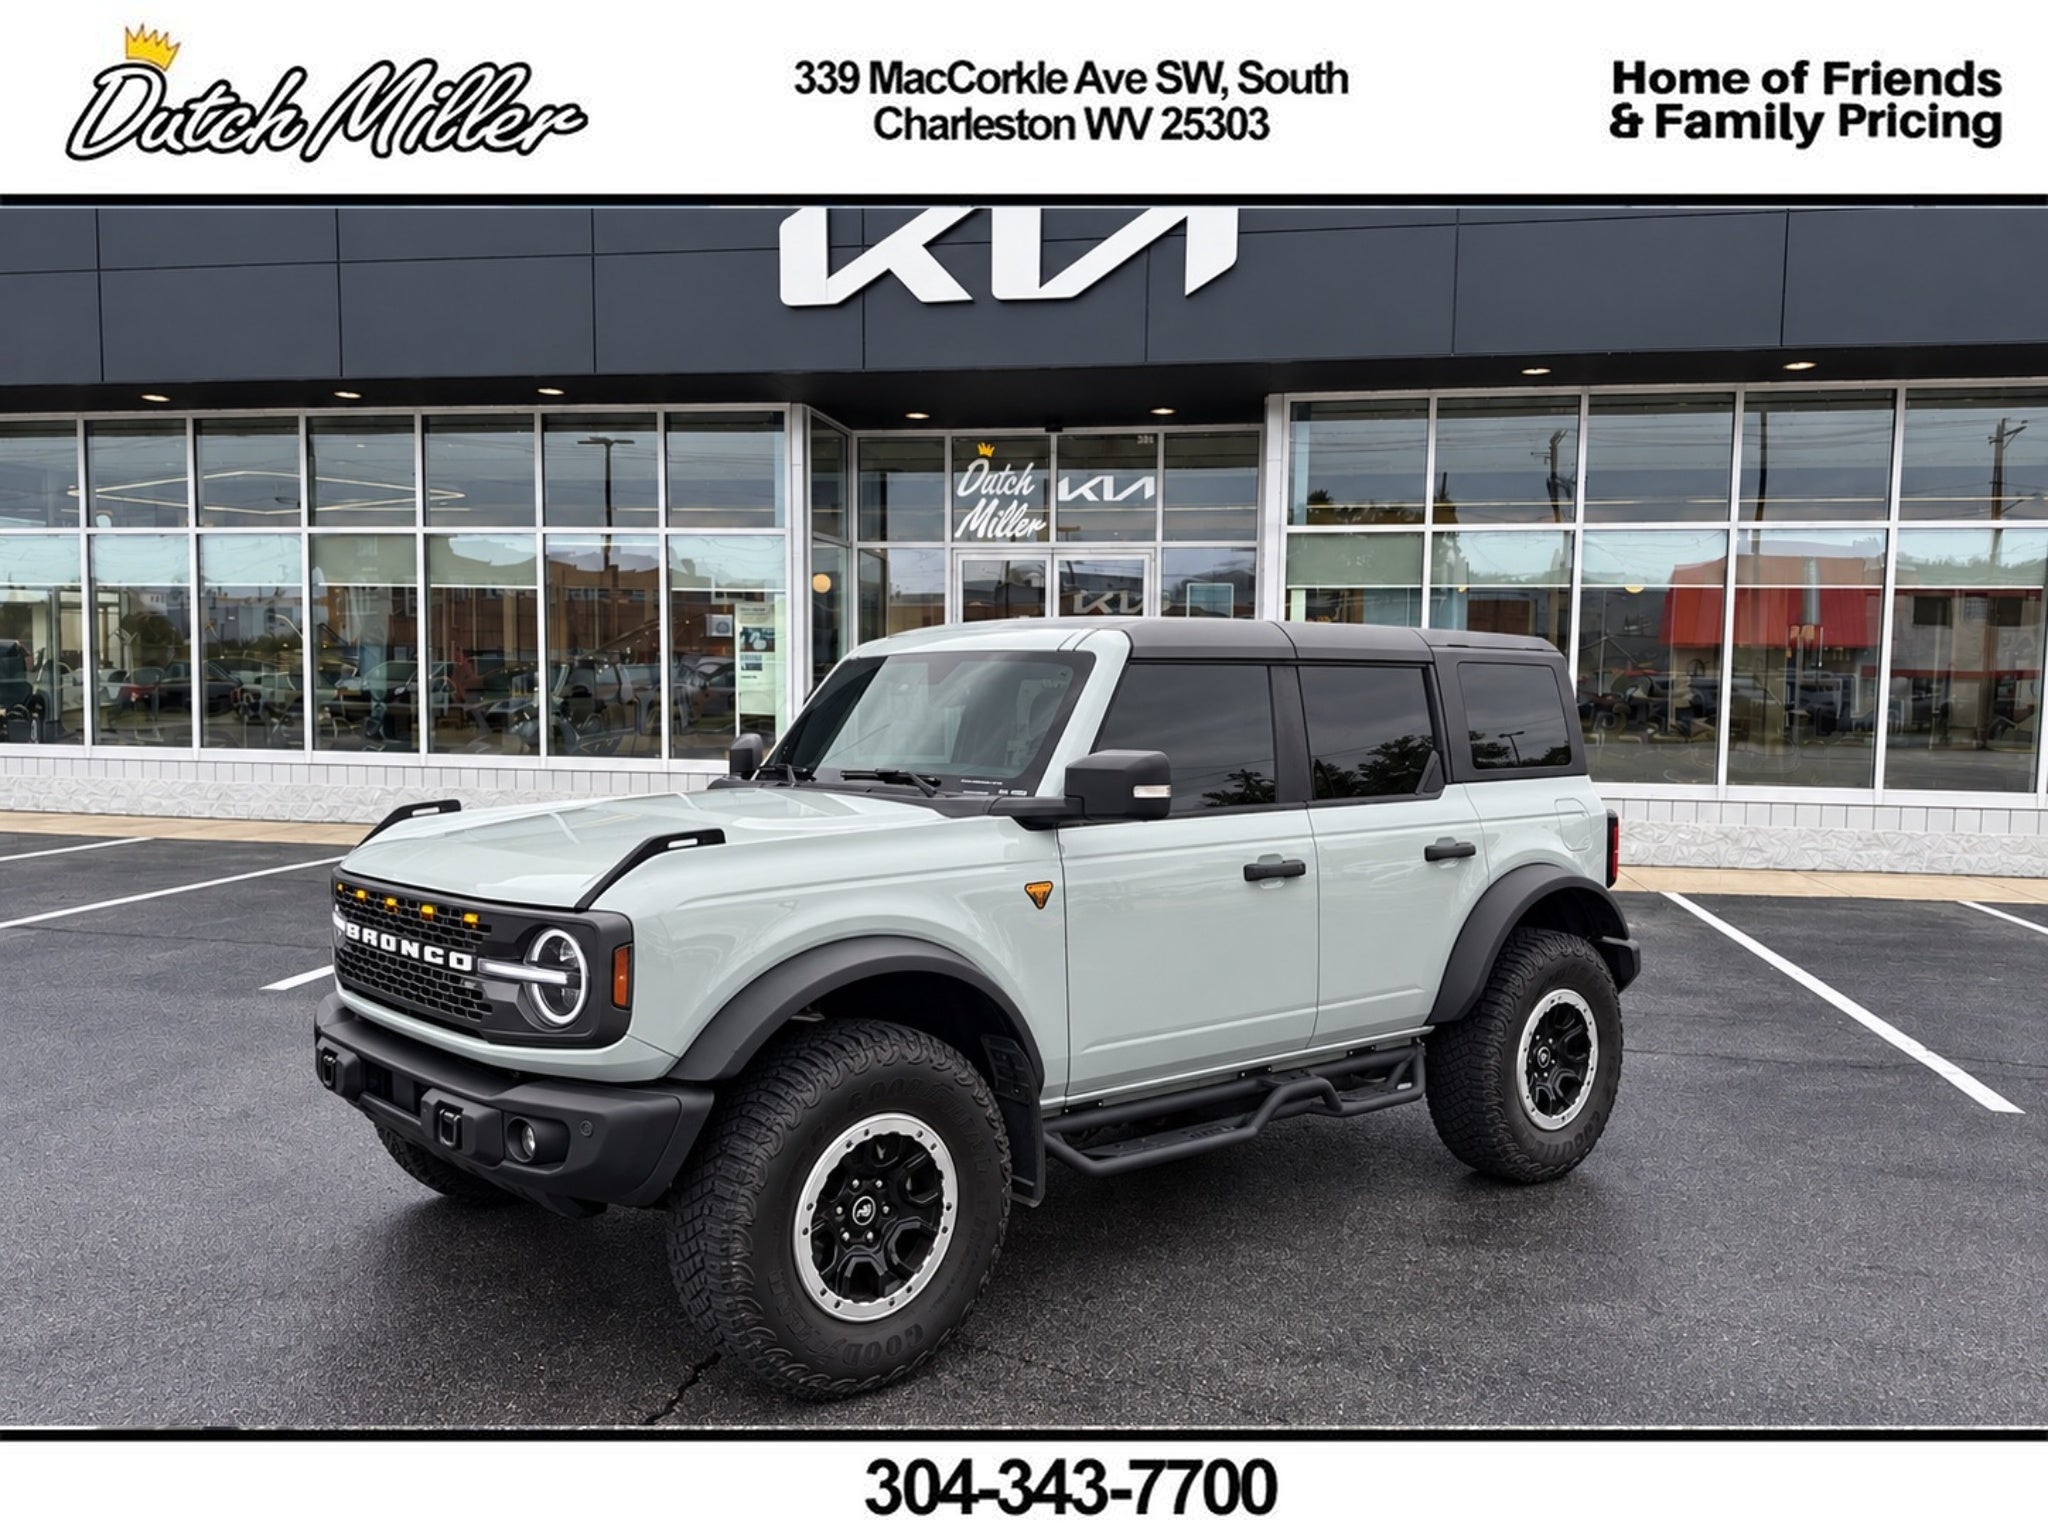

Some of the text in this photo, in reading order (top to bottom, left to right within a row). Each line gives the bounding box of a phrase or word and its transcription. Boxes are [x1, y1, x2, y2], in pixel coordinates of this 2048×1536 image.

[956, 457, 1035, 499] Dutch
[1058, 476, 1156, 502] KIA
[954, 497, 1047, 539] Miller
[345, 924, 473, 973] BRONCO
